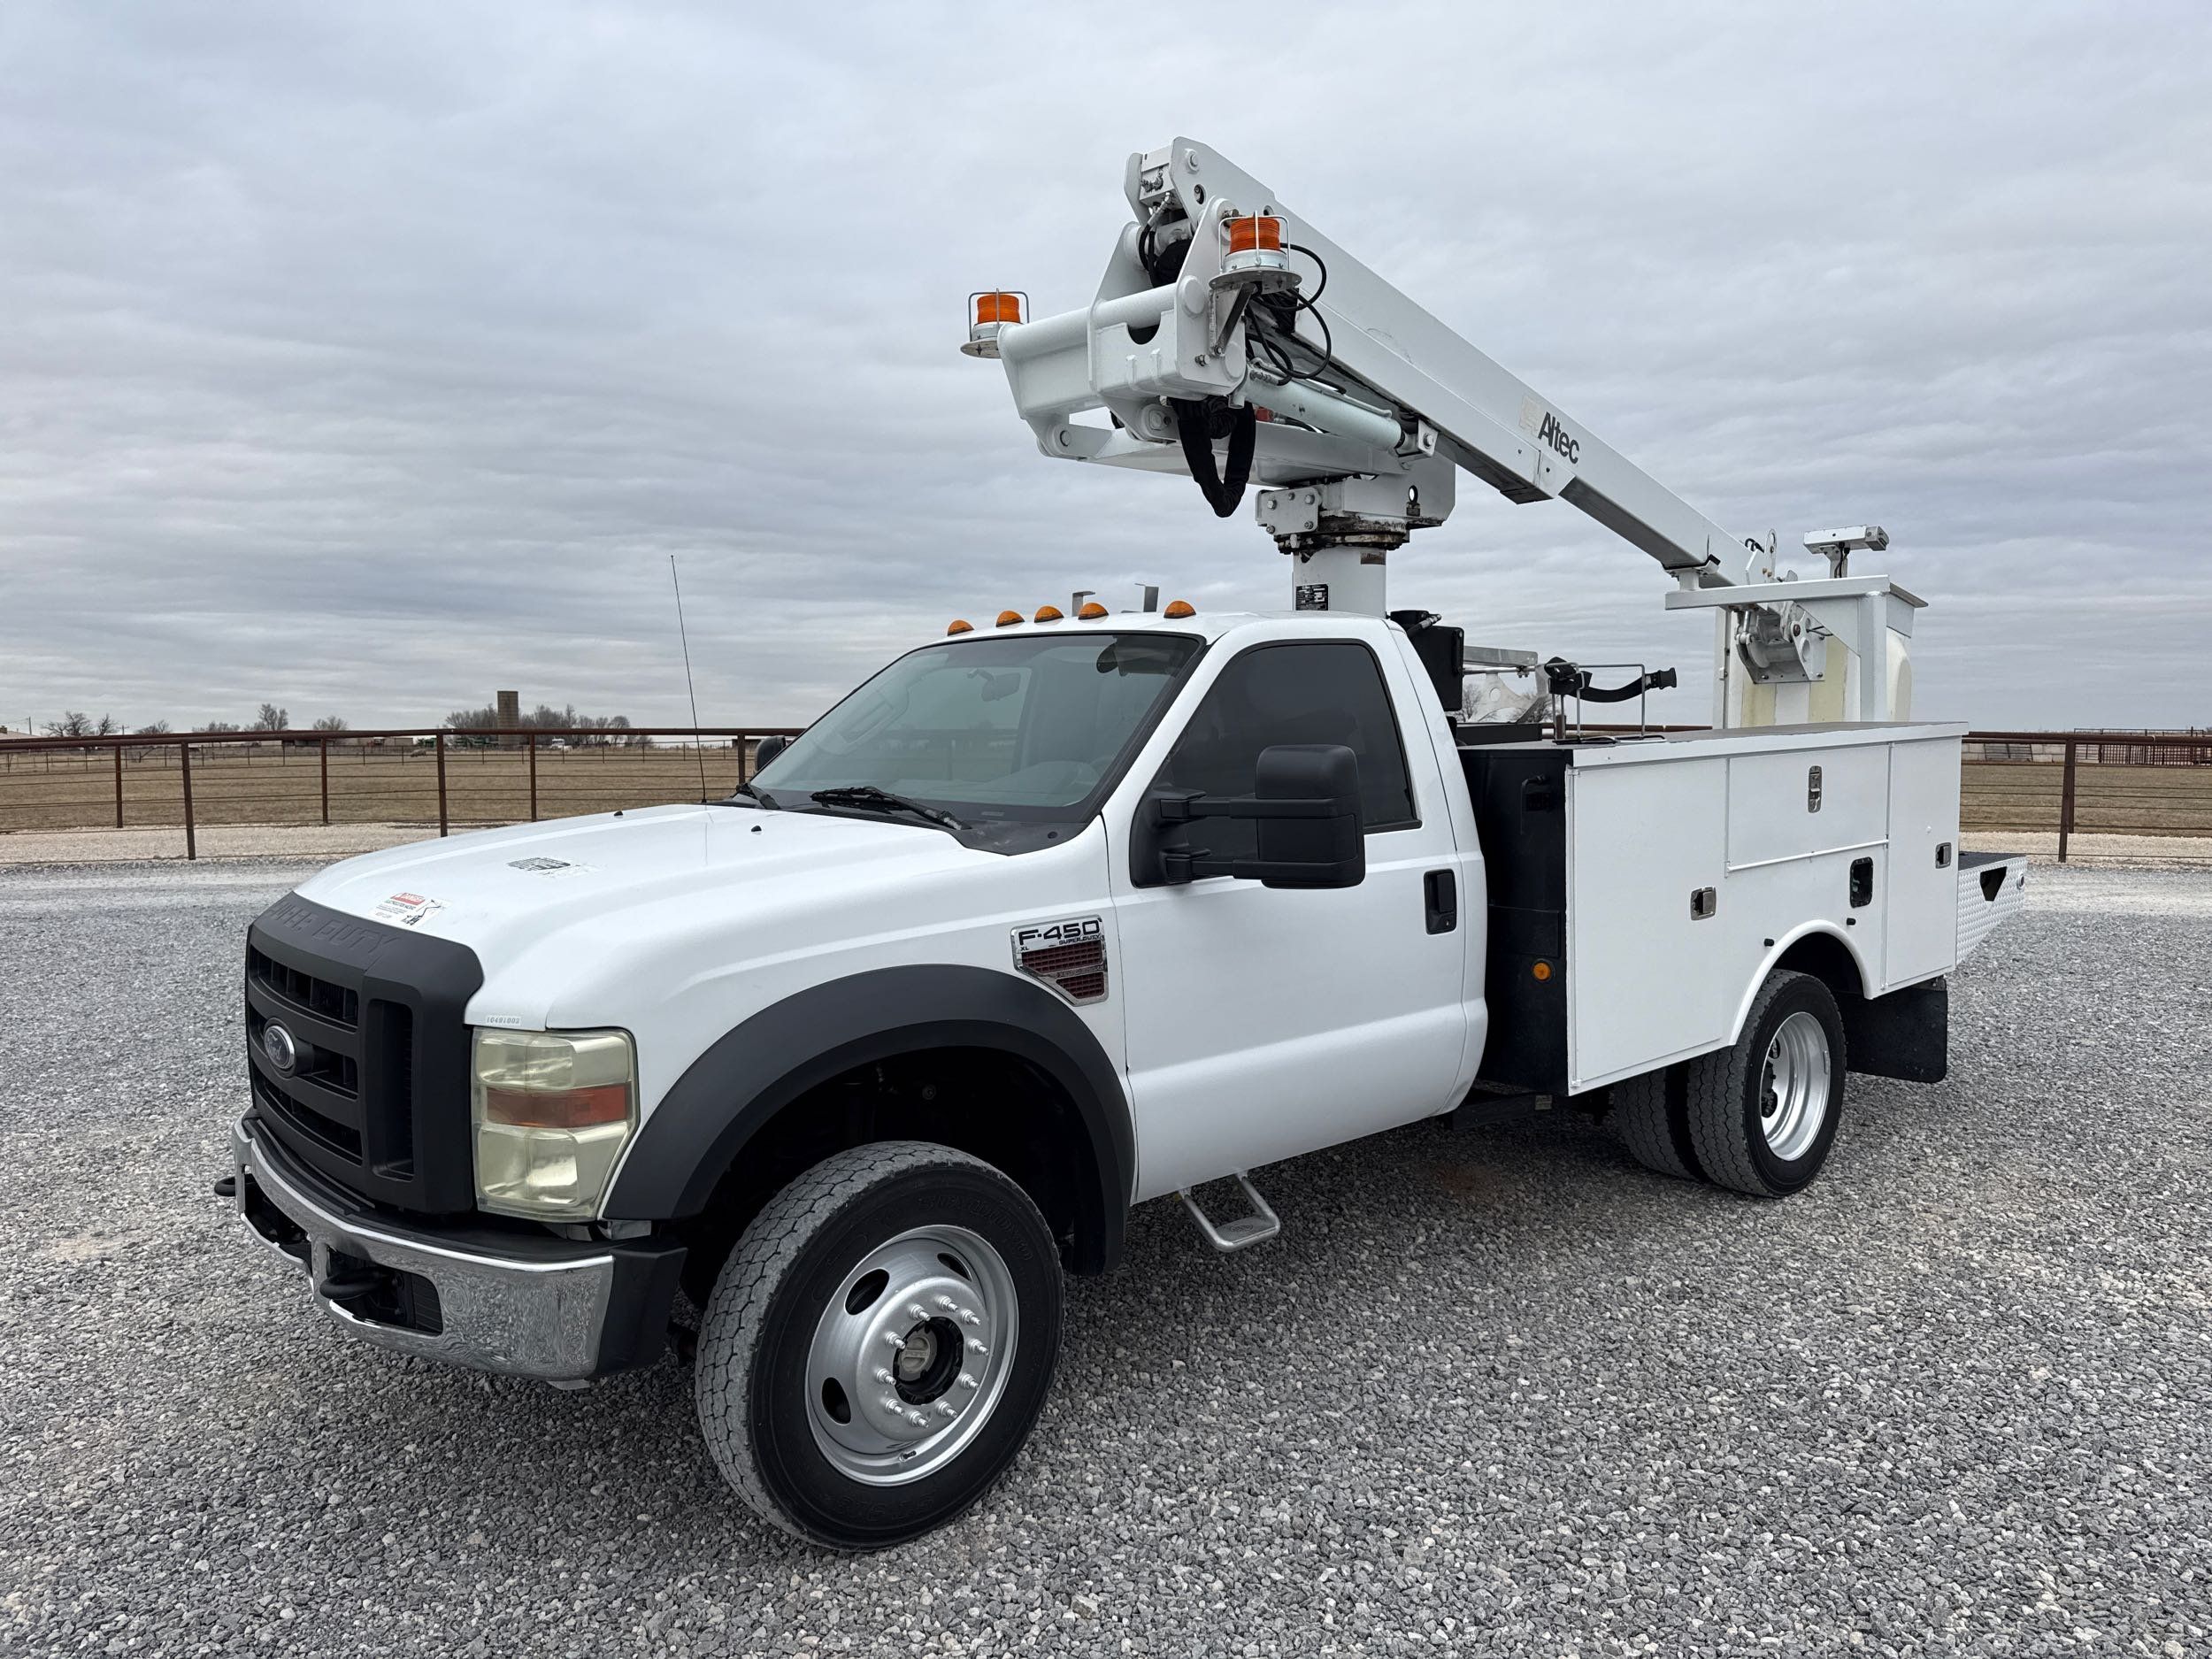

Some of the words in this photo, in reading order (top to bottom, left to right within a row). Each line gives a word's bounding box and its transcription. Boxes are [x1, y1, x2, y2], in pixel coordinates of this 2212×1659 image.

[1538, 411, 1579, 465] Altec
[312, 919, 401, 955] DUTY
[1018, 920, 1101, 946] F-450
[1058, 936, 1081, 946] SUPER
